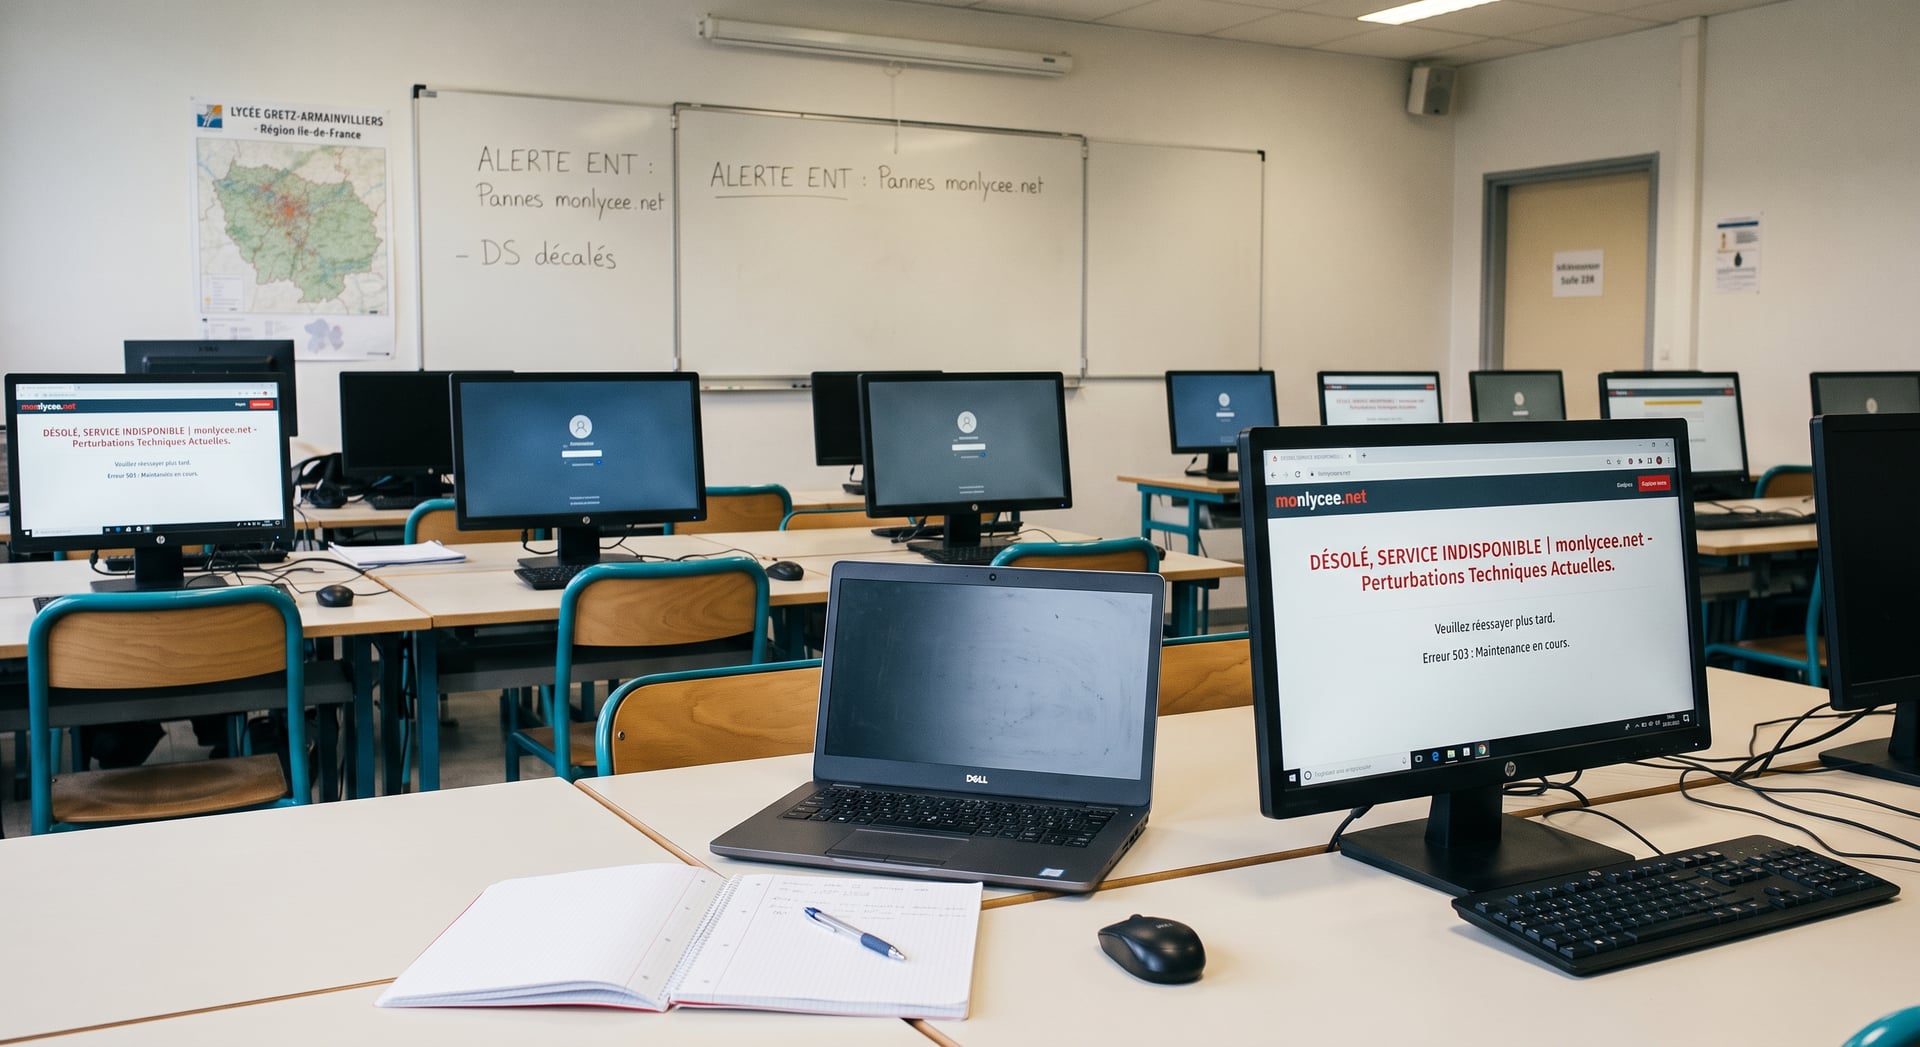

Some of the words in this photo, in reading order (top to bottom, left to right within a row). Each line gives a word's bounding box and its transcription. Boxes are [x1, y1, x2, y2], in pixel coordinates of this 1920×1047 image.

[231, 105, 260, 119] LYCÉE
[263, 108, 384, 127] GRETZ-ARMAINVILLIERS
[260, 124, 295, 136] Région
[478, 146, 571, 172] ALERTE
[587, 152, 638, 175] ENT
[711, 161, 794, 187] ALERTE
[808, 167, 853, 189] ENT
[878, 165, 935, 191] Pannes
[946, 171, 1044, 201] monlycee.net
[476, 182, 543, 208] Pannes
[556, 188, 664, 221] monlycee.net
[481, 239, 520, 265] DS
[535, 241, 617, 269] décalés
[43, 427, 81, 438] DÉSOLÉ,
[83, 427, 120, 436] SERVICE
[122, 427, 185, 436] INDISPONIBLE
[194, 426, 251, 436] monlycee.net
[72, 438, 135, 448] Perturbations
[137, 437, 186, 447] Techniques
[189, 437, 231, 446] Actuelles.
[1275, 489, 1367, 510] monlycee.net
[1310, 546, 1374, 571] DÉSOLÉ,
[1377, 546, 1438, 566] SERVICE
[1443, 538, 1542, 561] INDISPONIBLE
[1555, 532, 1645, 554] monlycee.net
[1362, 568, 1465, 592] Perturbations
[1468, 562, 1547, 584] Techniques
[1551, 556, 1615, 576] Actuelles.
[1435, 621, 1470, 635] Veuillez
[1472, 617, 1513, 632] réessayer
[1515, 615, 1533, 629] plus
[1535, 612, 1556, 625] tard.
[1423, 652, 1450, 664] Erreur
[1453, 648, 1469, 661] 503
[1475, 642, 1530, 658] Maintenance
[1532, 641, 1543, 652] en
[1545, 638, 1570, 650] cours.
[966, 774, 989, 784] DELL
